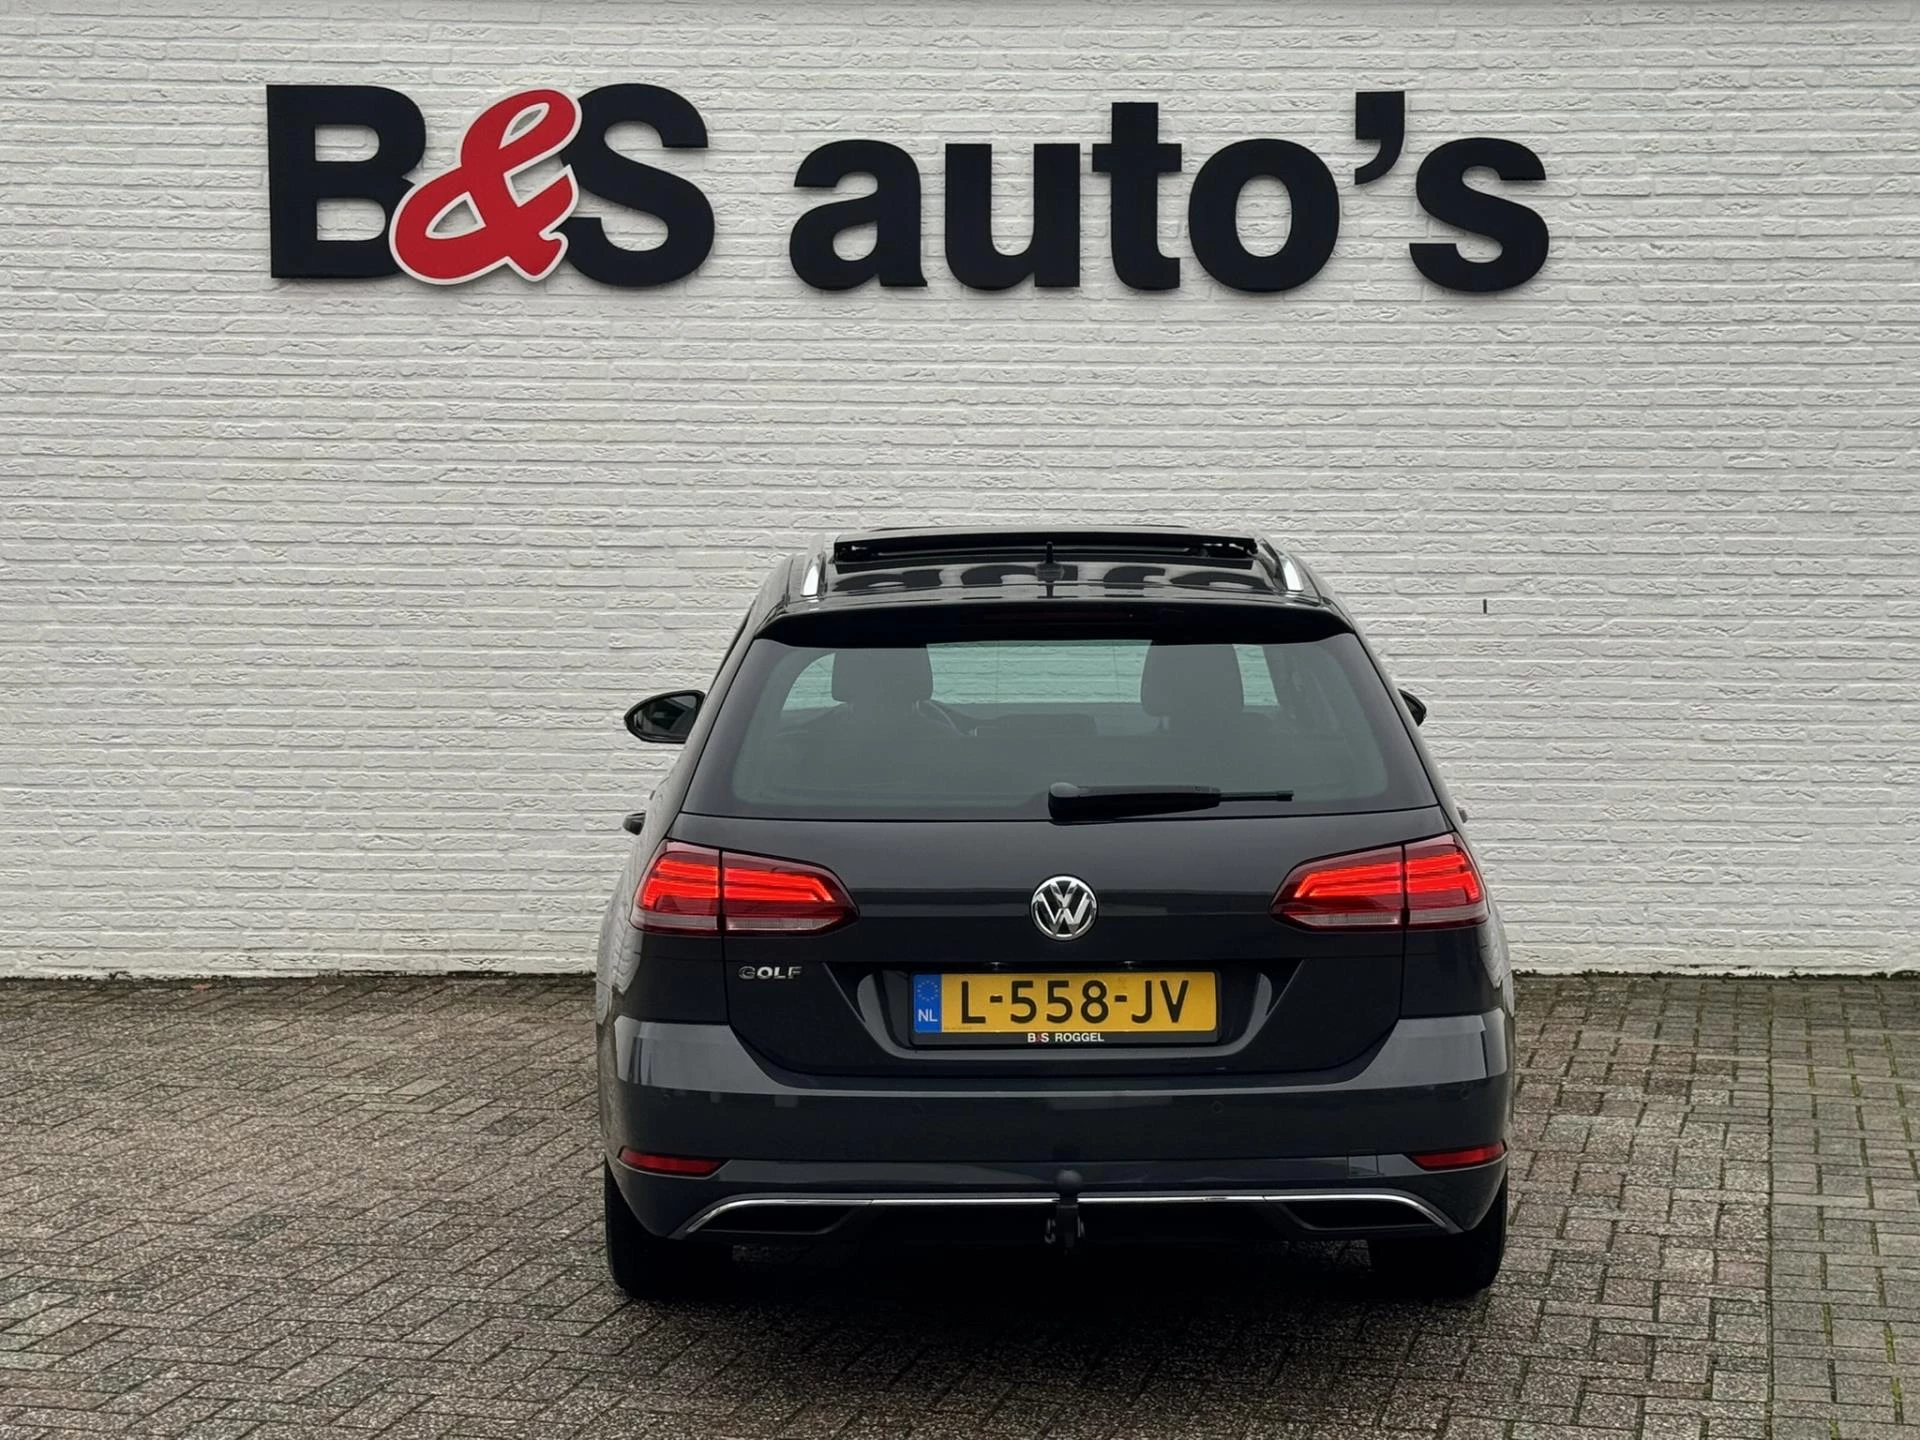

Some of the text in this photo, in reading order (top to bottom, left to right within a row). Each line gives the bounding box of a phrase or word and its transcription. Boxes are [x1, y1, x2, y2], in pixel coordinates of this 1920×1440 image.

[266, 83, 1549, 292] B&S auto's
[739, 965, 802, 979] GOLF
[961, 980, 1189, 1024] L-558-JV
[917, 1008, 938, 1022] NL
[1055, 1032, 1105, 1043] ROGGEL
